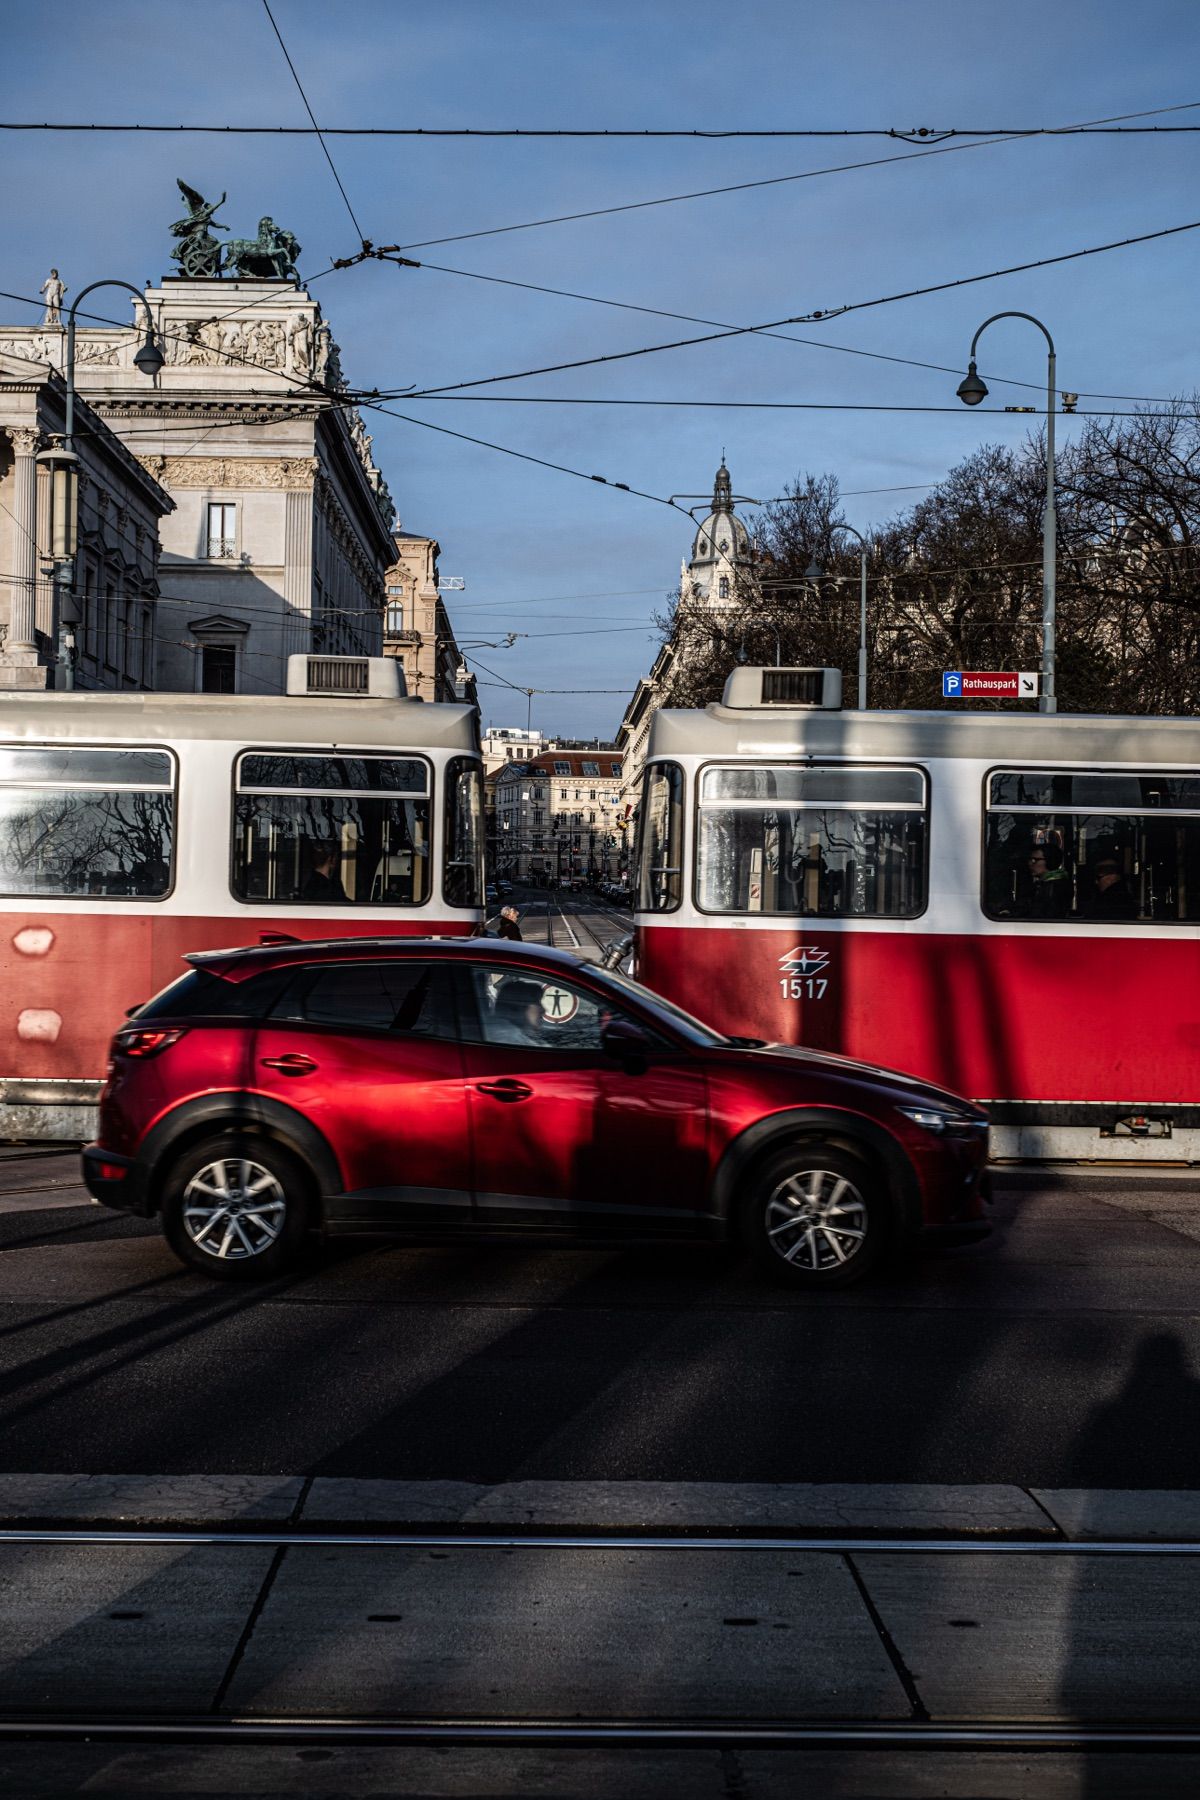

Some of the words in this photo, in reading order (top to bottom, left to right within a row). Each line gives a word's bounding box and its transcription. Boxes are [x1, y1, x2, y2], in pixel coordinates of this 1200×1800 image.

[948, 680, 958, 692] P
[963, 679, 1017, 691] Rathauspark
[780, 979, 828, 999] 1517
